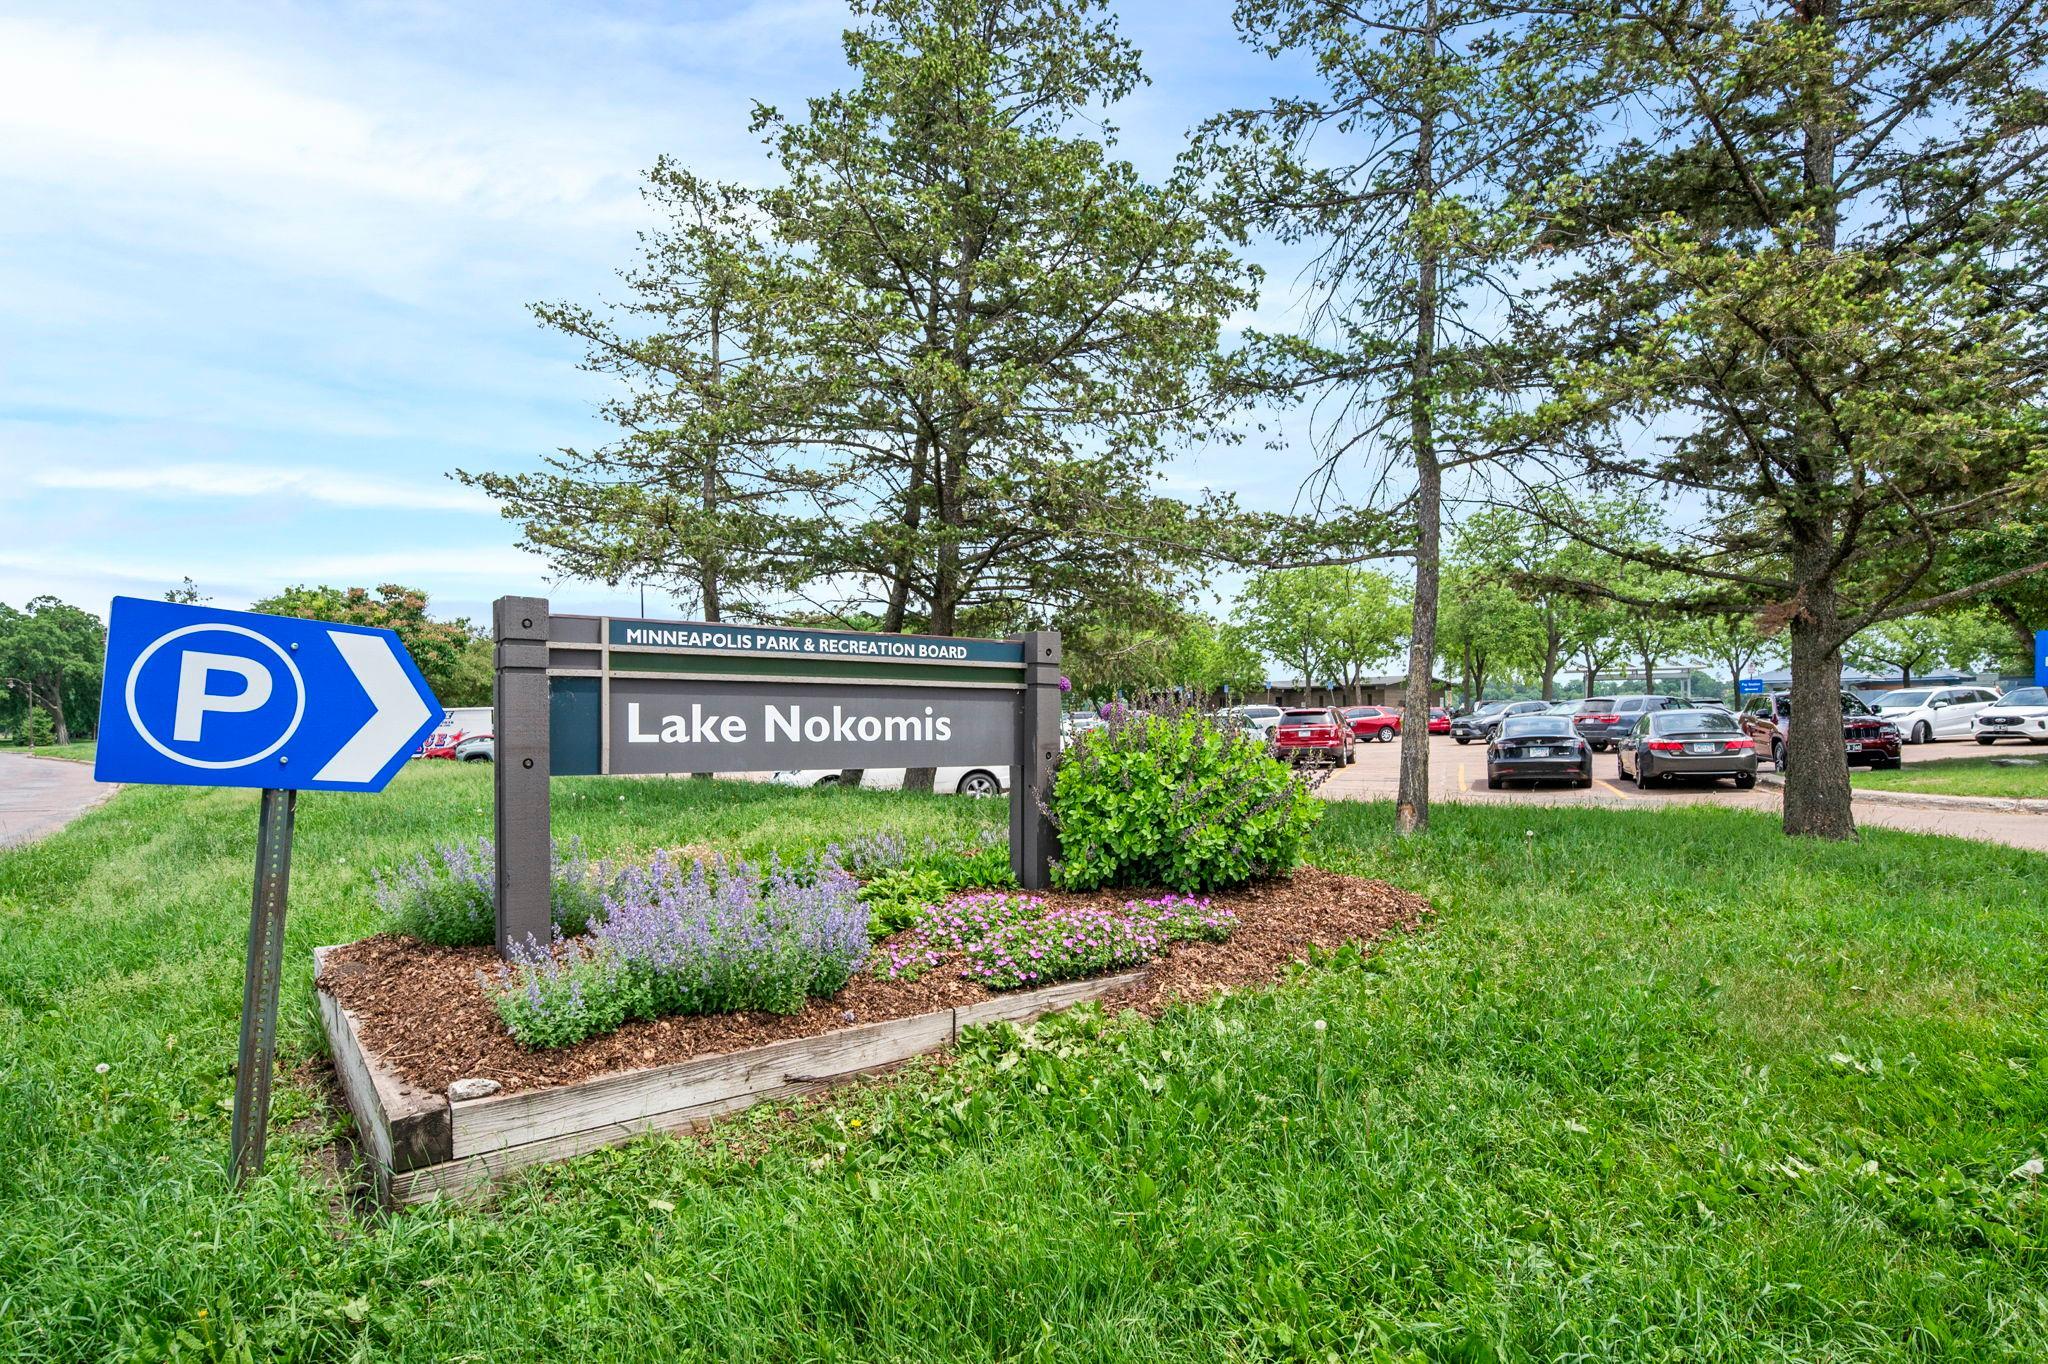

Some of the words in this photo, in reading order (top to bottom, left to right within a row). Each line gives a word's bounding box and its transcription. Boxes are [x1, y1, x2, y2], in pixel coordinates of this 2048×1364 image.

[626, 628, 752, 649] MINNEAPOLIS
[757, 635, 800, 651] PARK
[804, 637, 815, 652] &
[819, 638, 915, 657] RECREATION
[918, 644, 967, 660] BOARD
[173, 650, 273, 743] P
[627, 702, 747, 744] Lake
[764, 704, 952, 743] Nokomis
